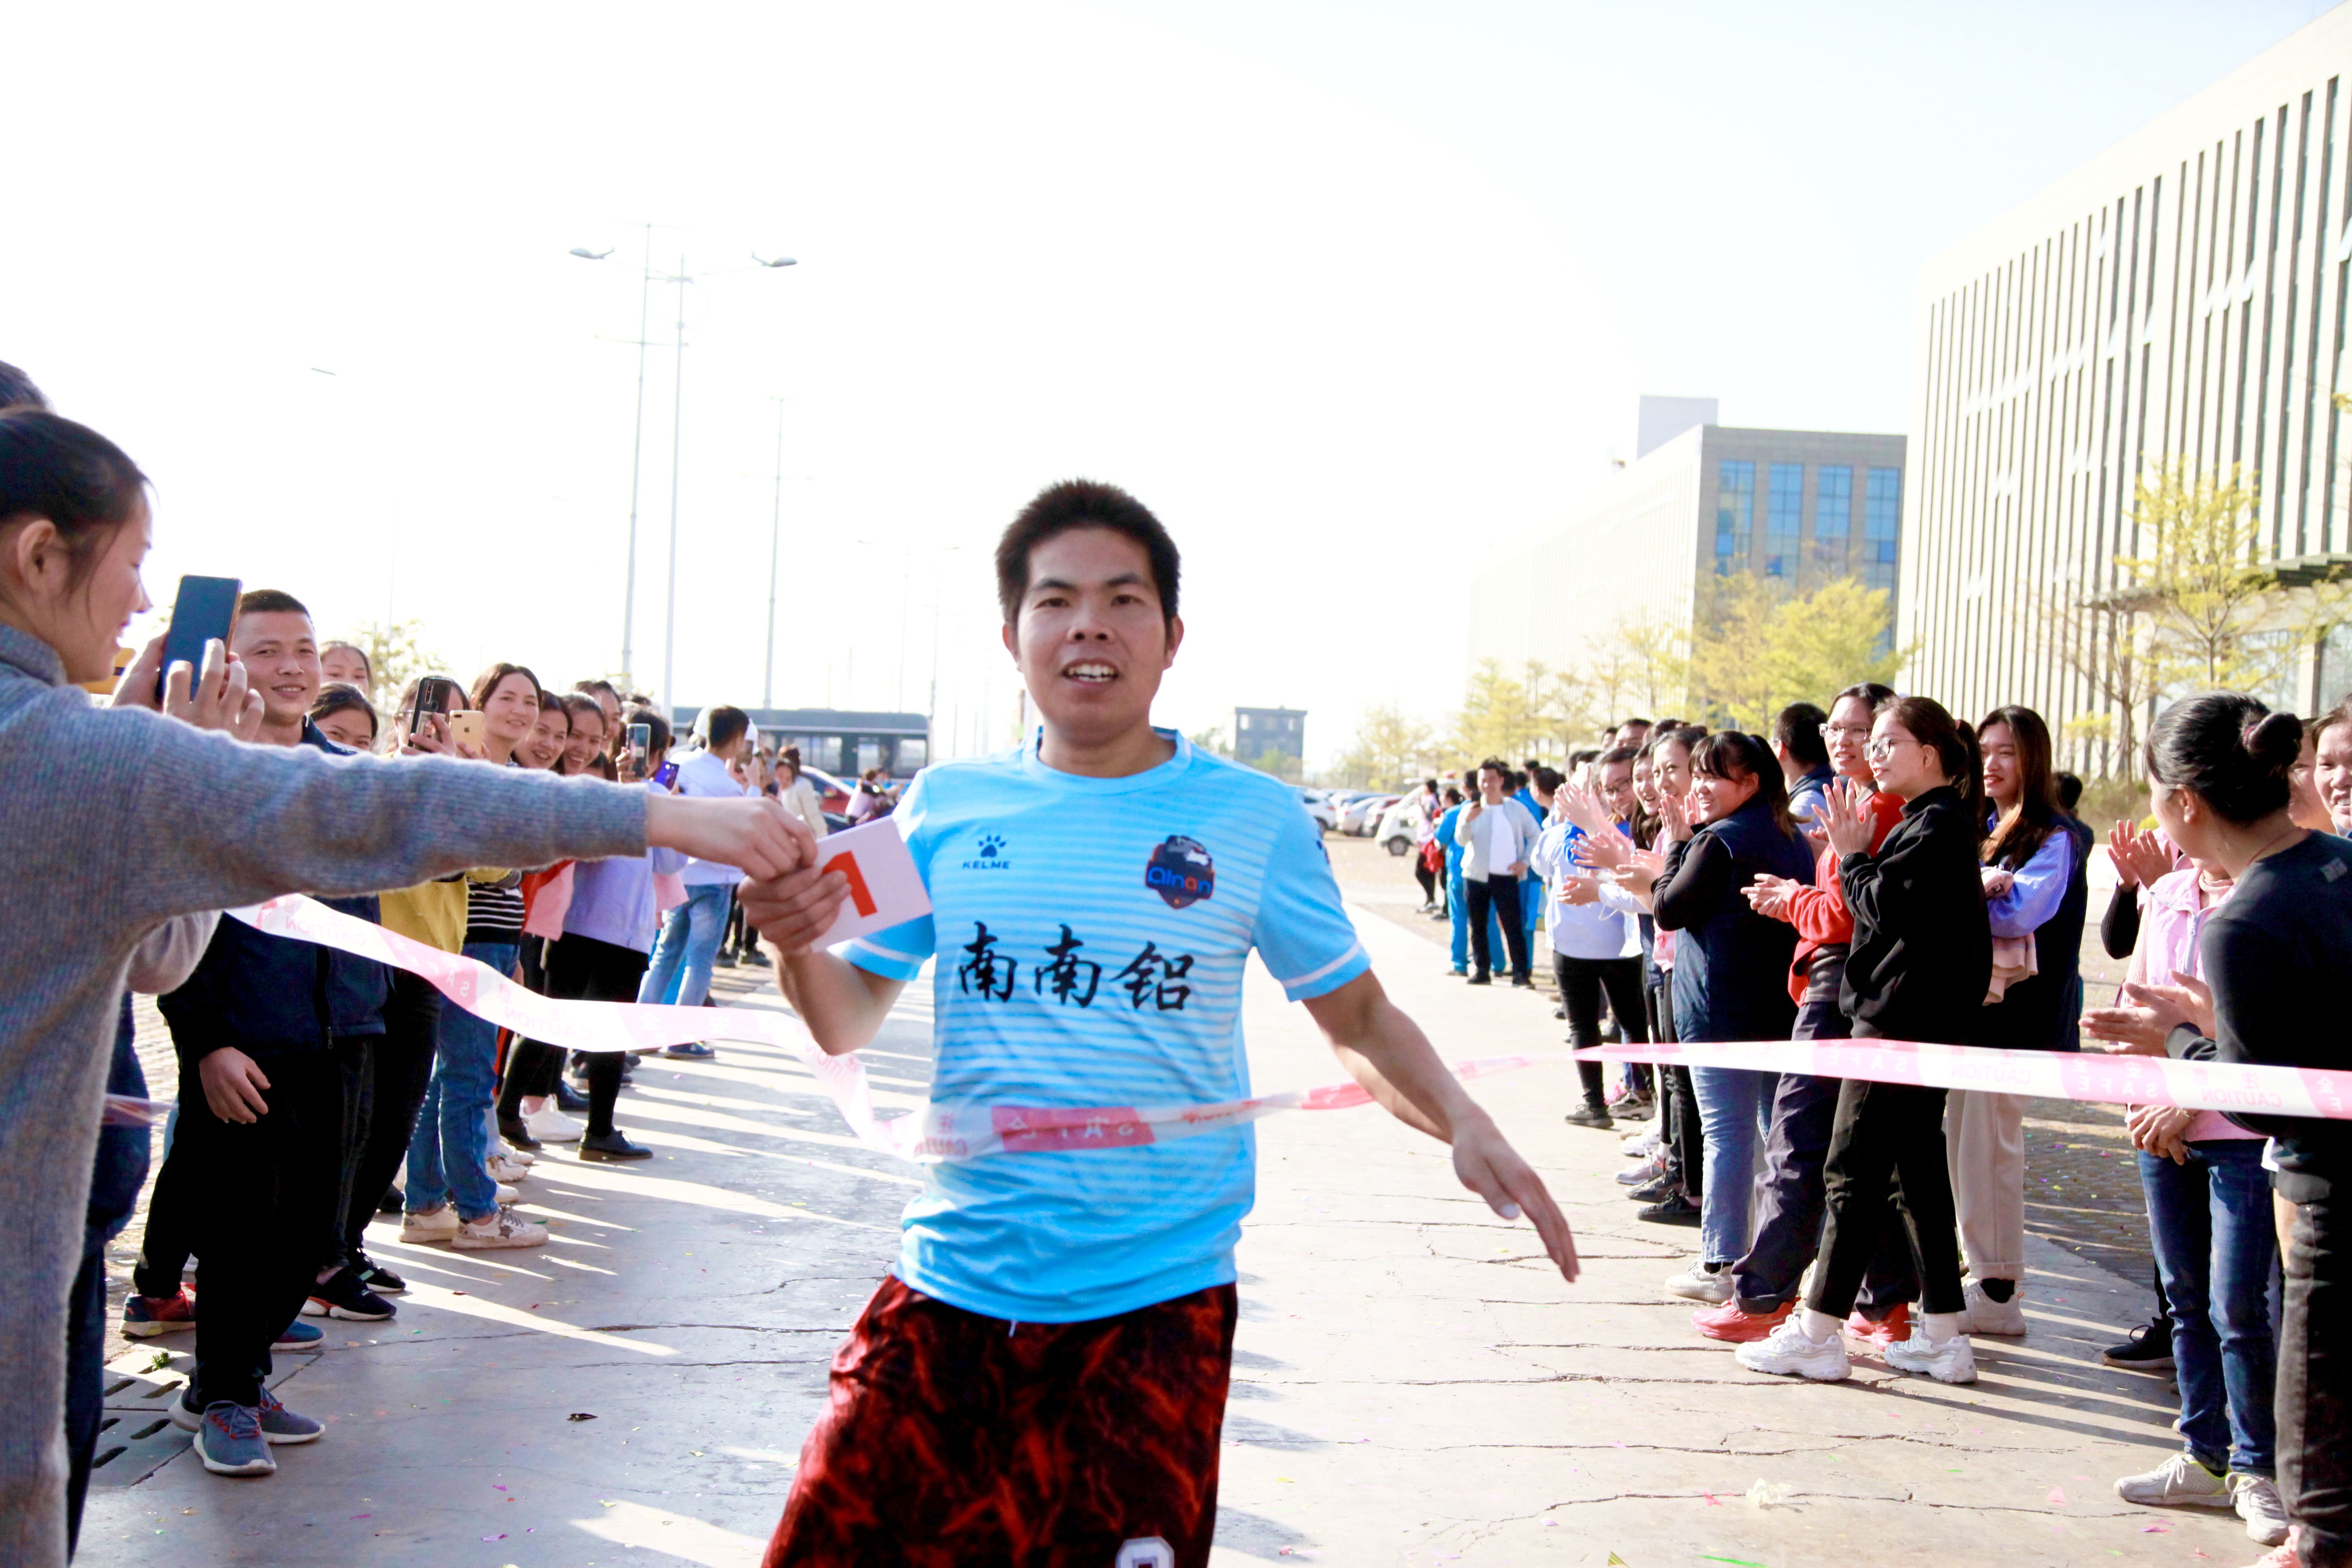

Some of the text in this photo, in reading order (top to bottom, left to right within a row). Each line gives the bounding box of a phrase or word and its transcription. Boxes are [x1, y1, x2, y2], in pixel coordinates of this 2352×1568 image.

[962, 860, 1011, 869] KELME
[959, 921, 1195, 1011] 南南铝
